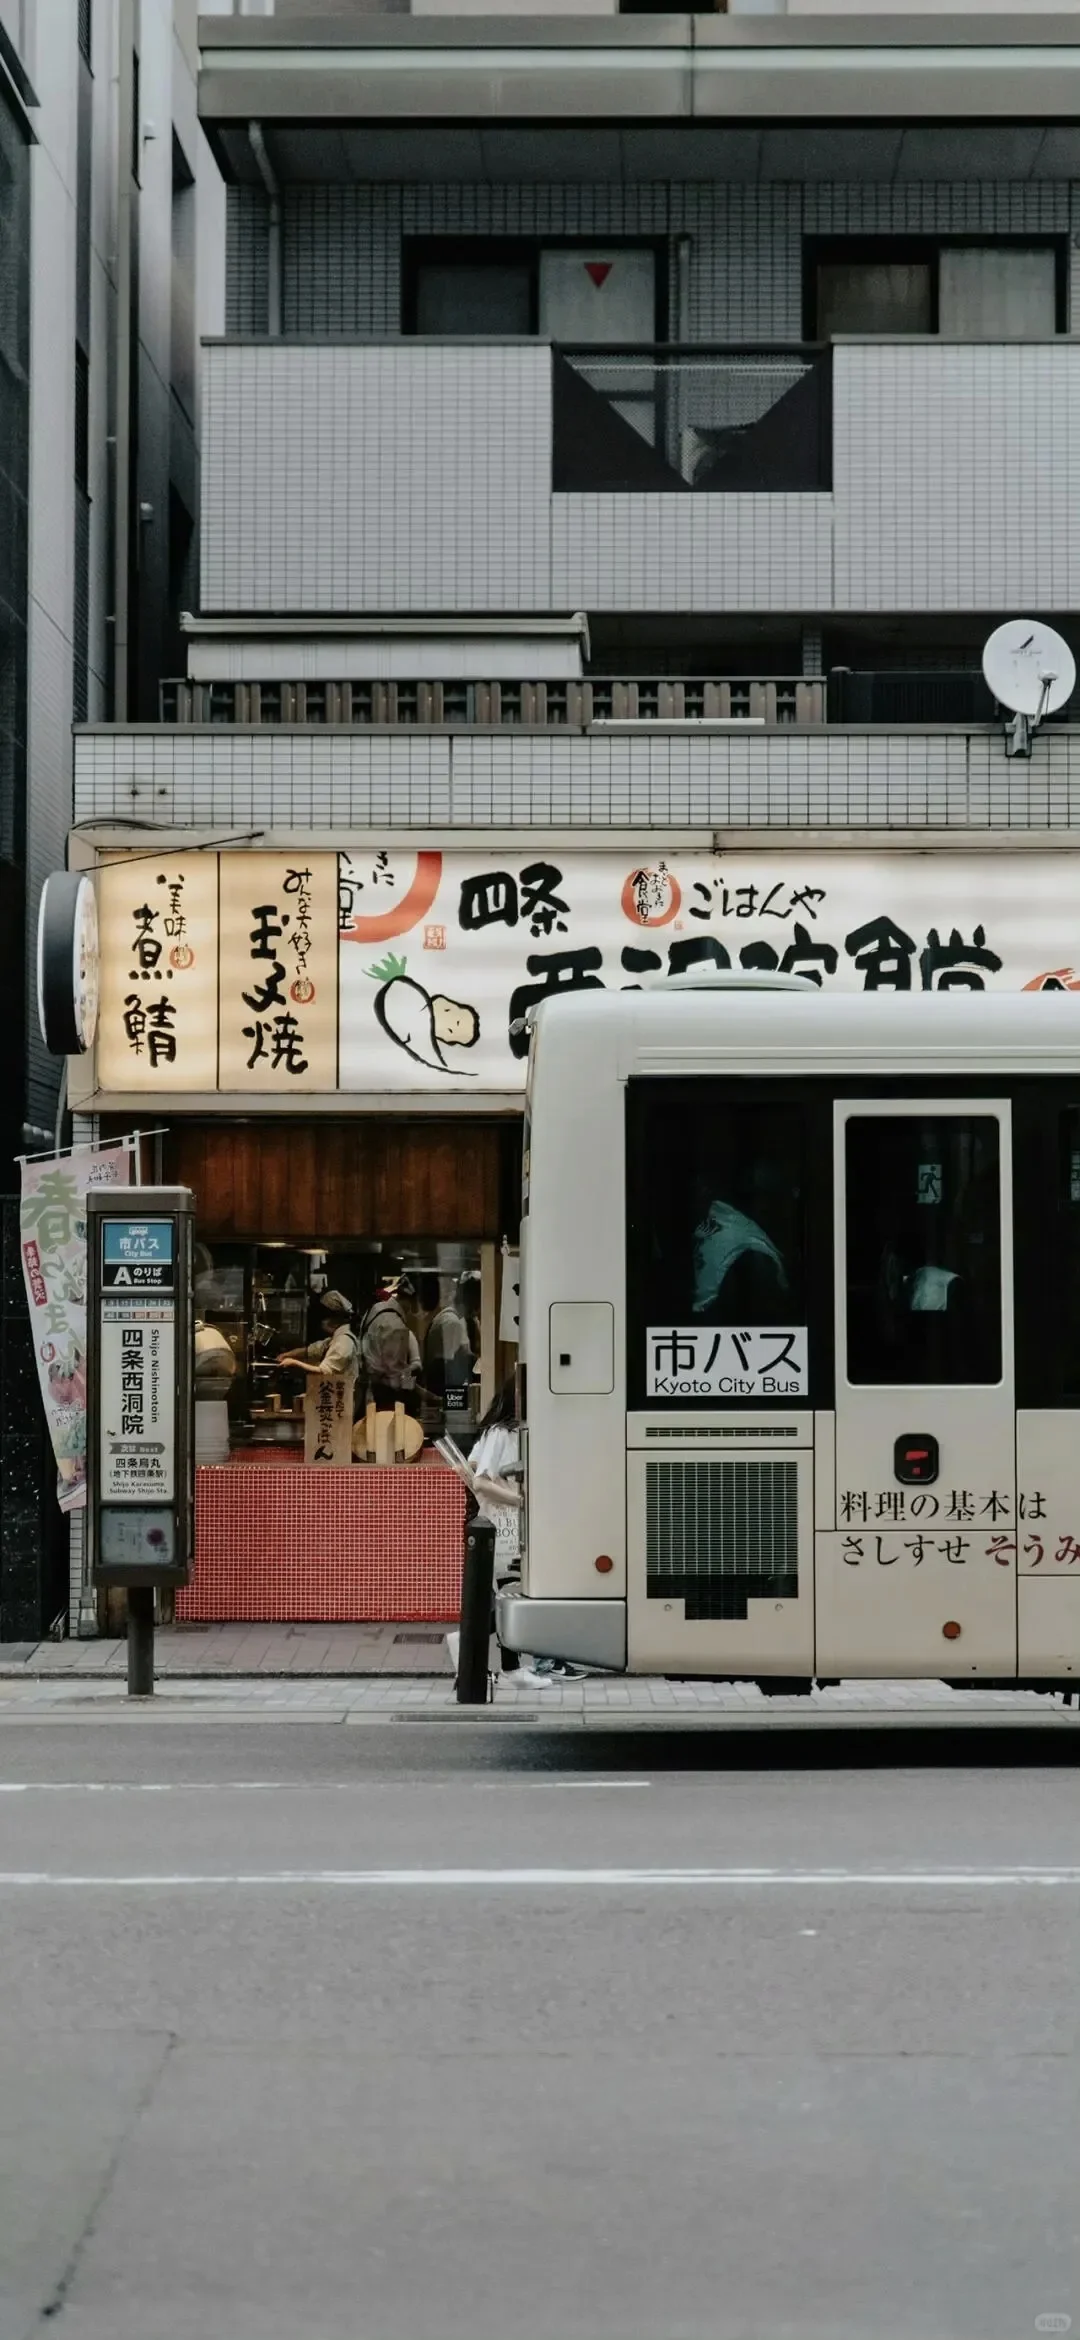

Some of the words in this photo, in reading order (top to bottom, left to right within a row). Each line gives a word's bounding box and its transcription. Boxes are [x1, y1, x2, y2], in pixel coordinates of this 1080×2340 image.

[156, 873, 188, 937] 美味
[458, 862, 570, 938] 四条
[632, 871, 652, 923] 食堂
[688, 878, 826, 919] ごはんや
[283, 869, 313, 974] みんな大好き
[124, 903, 177, 1068] 煮鯖
[241, 905, 309, 1075] 玉子焼
[119, 1237, 159, 1250] 市バス
[124, 1250, 138, 1258] City
[113, 1266, 132, 1285] A
[133, 1267, 163, 1277] のりば
[149, 1329, 159, 1357] Shijo
[652, 1330, 801, 1376] 市バス
[121, 1329, 144, 1435] 四条西洞院
[151, 1361, 161, 1423] Nishinotoin
[655, 1377, 711, 1394] Kyoto
[718, 1377, 755, 1394] City
[762, 1377, 800, 1392] Bus
[116, 1457, 161, 1469] 四条烏丸
[840, 1490, 1047, 1522] 料理の基本は
[841, 1535, 970, 1567] さしすせ
